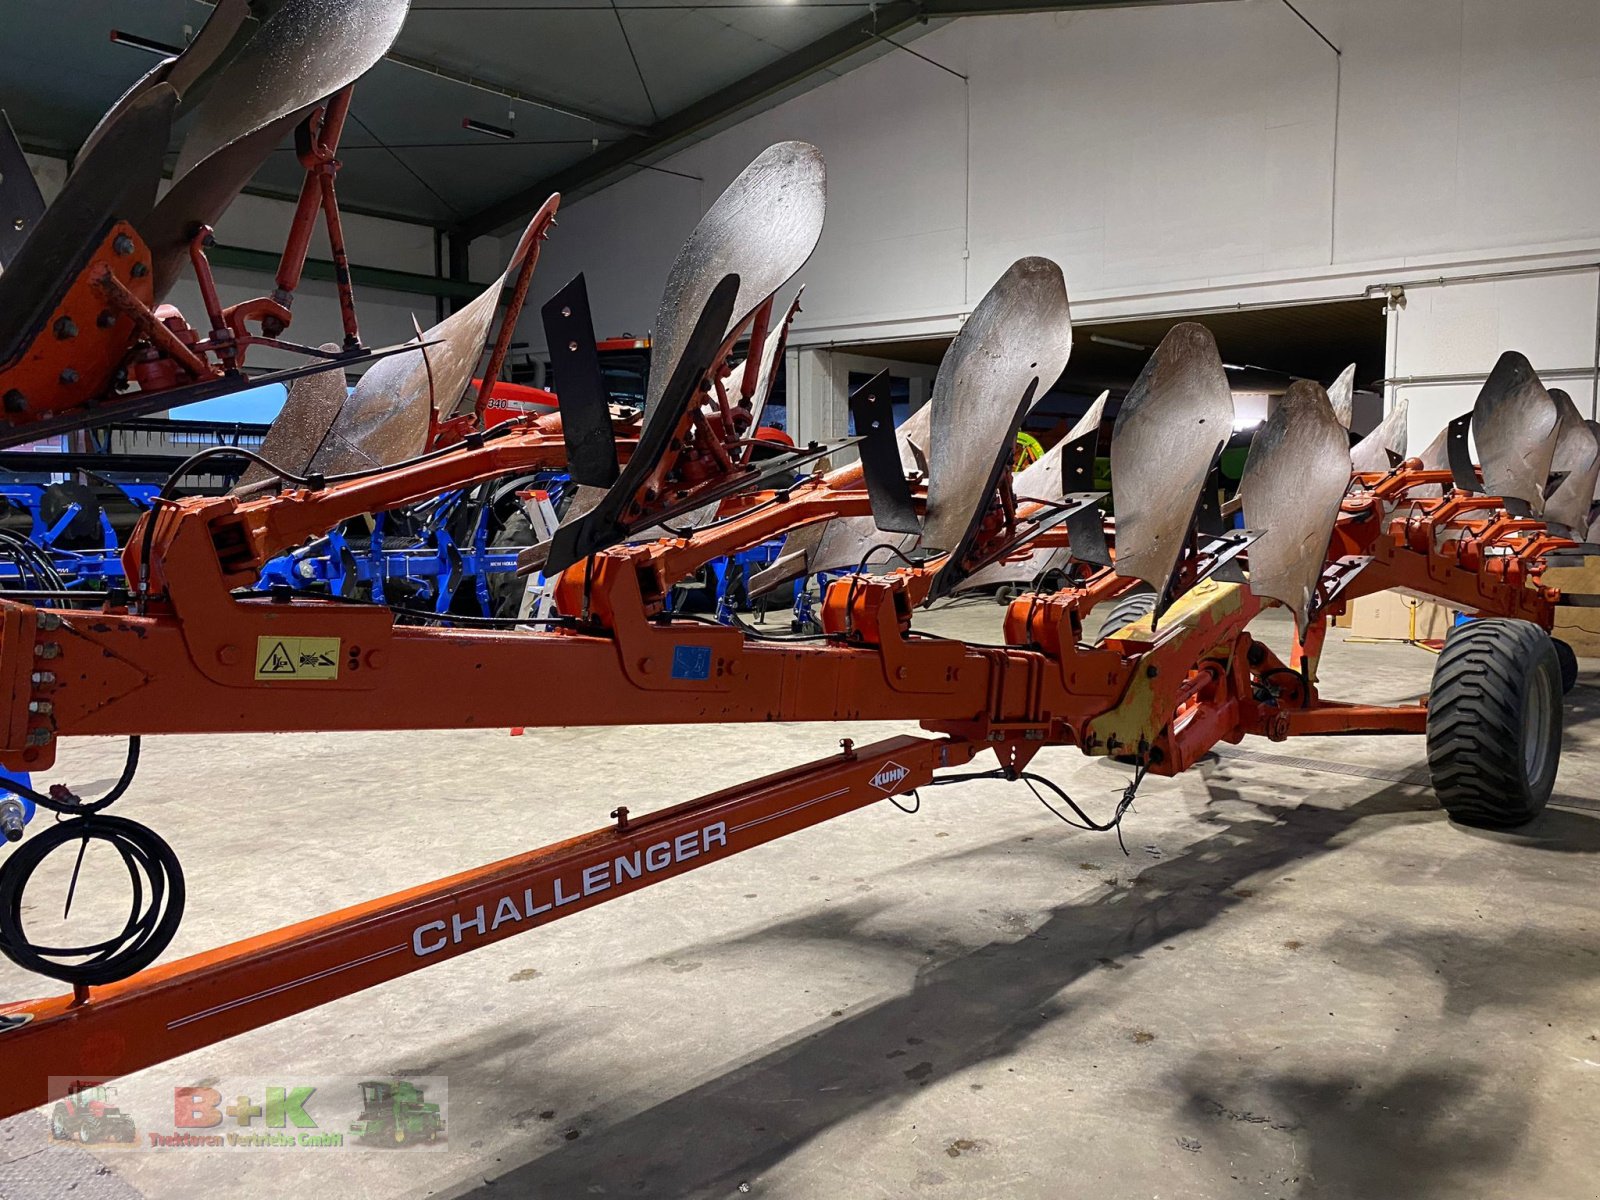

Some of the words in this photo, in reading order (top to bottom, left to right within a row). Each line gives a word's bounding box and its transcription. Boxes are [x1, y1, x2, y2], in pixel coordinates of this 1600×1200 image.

[488, 398, 506, 409] 340
[874, 767, 905, 786] KUHN
[412, 820, 728, 957] CHALLENGER
